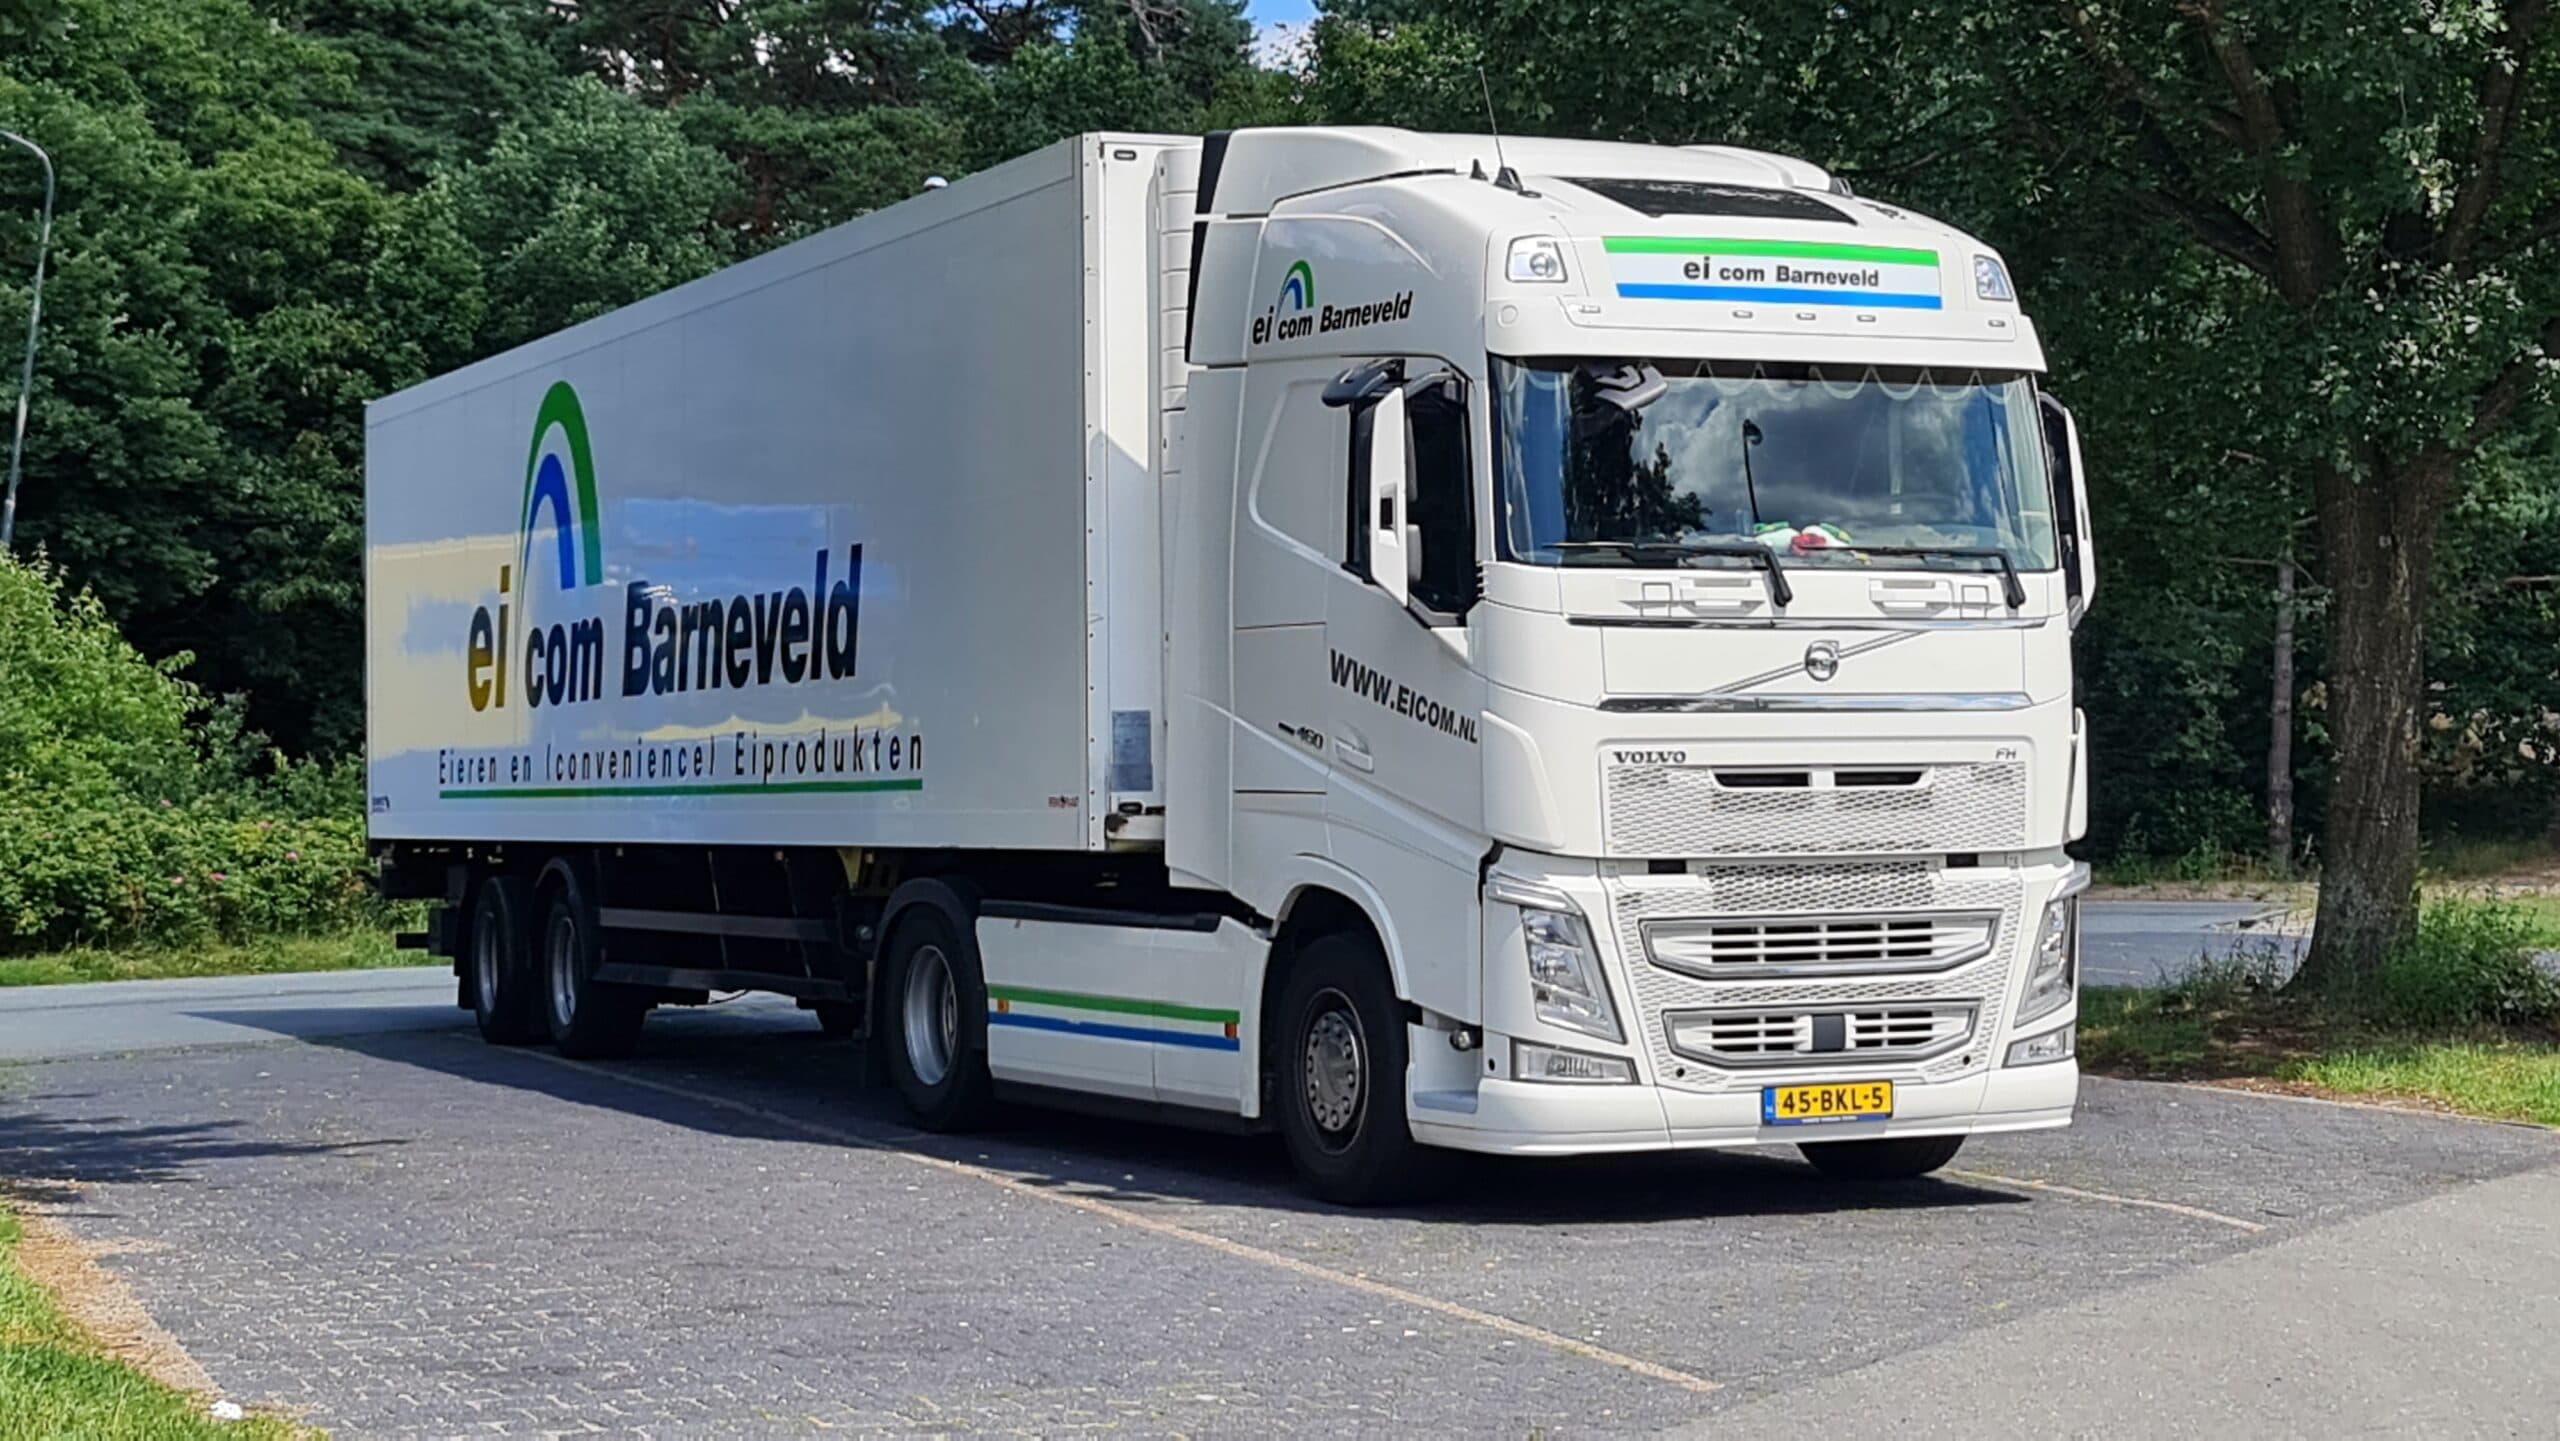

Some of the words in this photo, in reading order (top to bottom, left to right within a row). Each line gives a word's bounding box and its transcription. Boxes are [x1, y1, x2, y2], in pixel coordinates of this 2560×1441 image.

[1683, 256, 1711, 280] ei
[1719, 266, 1765, 283] com
[1775, 265, 1880, 288] Barneveld
[1252, 305, 1274, 345] ei
[1277, 314, 1314, 340] com
[1319, 290, 1414, 333] Barneveld
[467, 564, 511, 713] ei
[525, 615, 603, 709] com
[621, 543, 864, 697] Barneveld
[1329, 648, 1479, 744] WWW.EICOM.NL
[439, 749, 497, 785] Eieren
[510, 753, 532, 784] en
[545, 733, 716, 783] (convenience)
[734, 725, 923, 785] Eiprodukten
[1613, 750, 1687, 765] VOLVO
[1995, 747, 2017, 761] FH
[1781, 1086, 1884, 1114] 45-BKL-5
